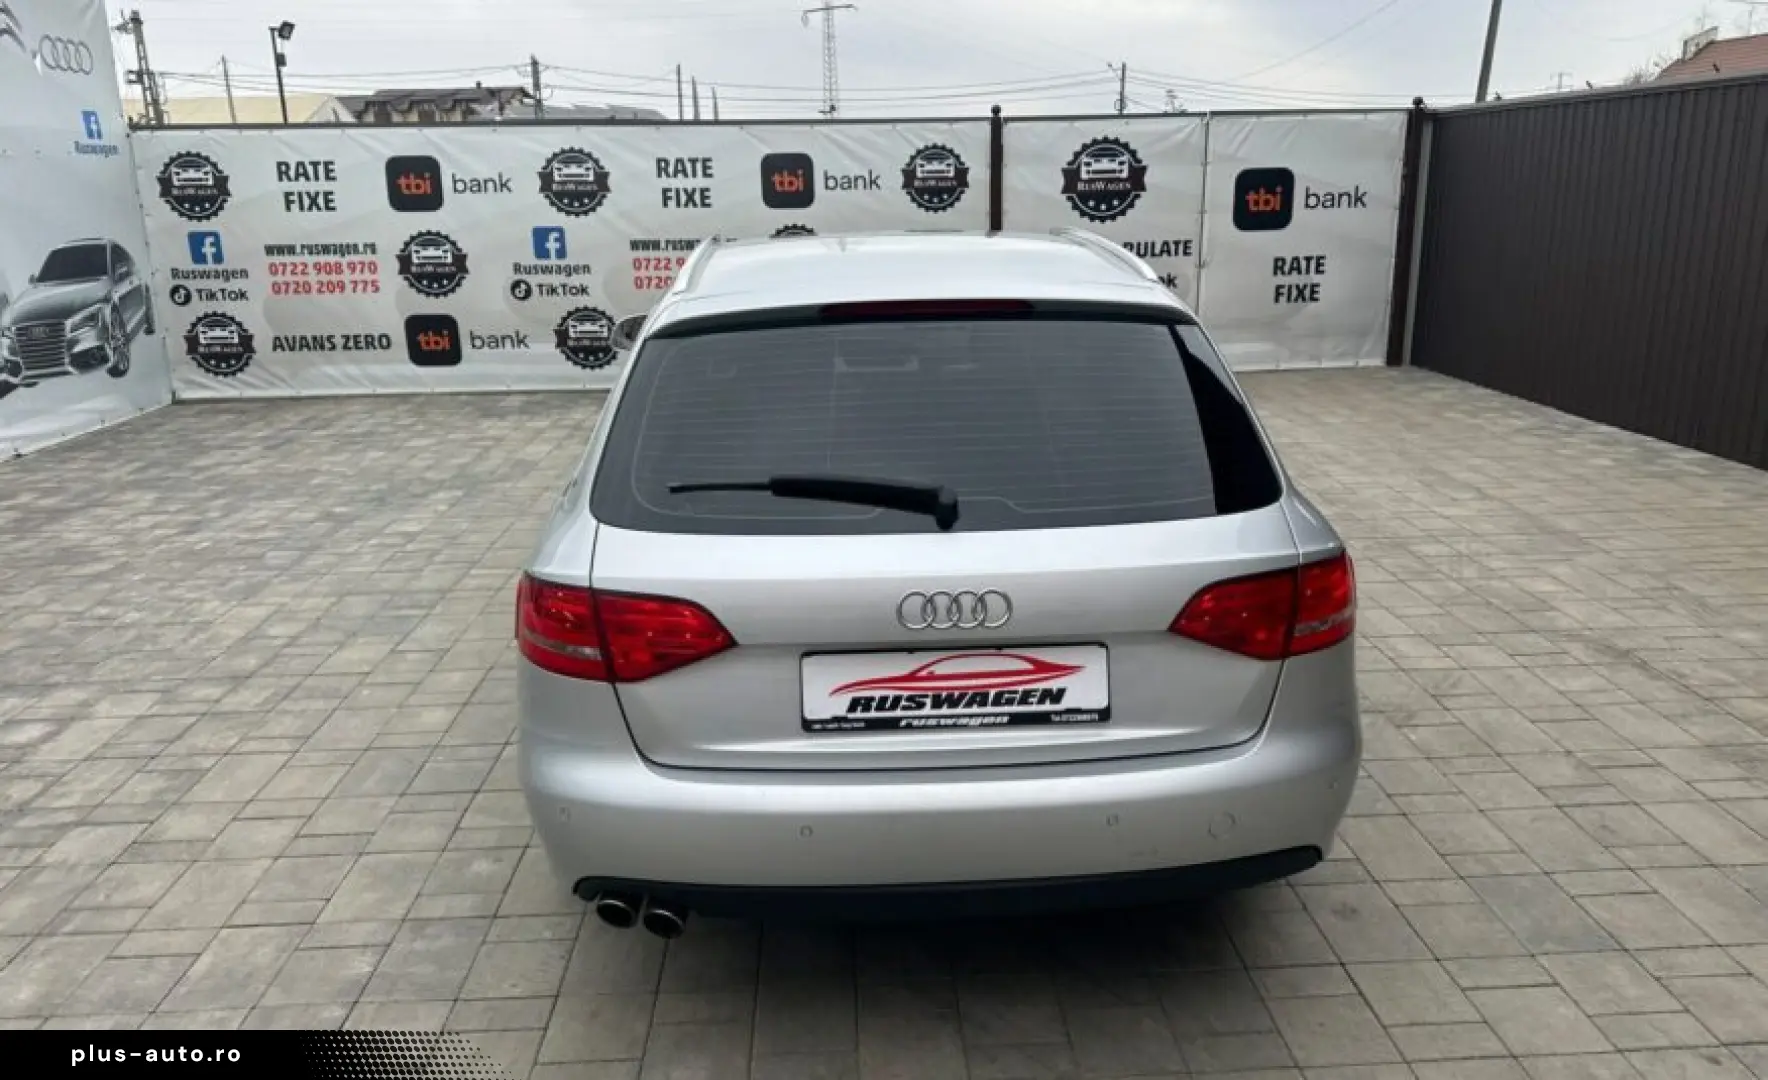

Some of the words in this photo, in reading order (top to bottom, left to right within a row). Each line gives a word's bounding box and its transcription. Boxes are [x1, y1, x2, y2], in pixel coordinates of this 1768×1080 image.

[275, 160, 338, 182] RATE
[655, 157, 714, 178] RATE
[397, 172, 433, 195] tbi
[452, 173, 513, 194] bank
[770, 169, 804, 192] tbi
[823, 169, 882, 191] bank
[283, 190, 338, 212] FIXE
[660, 187, 713, 209] FIXE
[1246, 185, 1284, 211] tbi
[1304, 184, 1368, 209] bank
[170, 267, 249, 281] Ruswagen
[268, 261, 309, 275] 0722
[313, 261, 344, 275] 908
[347, 260, 378, 275] 970
[512, 261, 592, 276] Ruswagen
[632, 257, 672, 271] 0722
[1272, 254, 1326, 276] RATE
[196, 287, 249, 302] TikTok
[272, 280, 312, 295] 0720
[316, 279, 345, 294] 209
[350, 278, 381, 293] 775
[535, 283, 590, 298] TikTok
[1273, 282, 1321, 304] FIXE
[271, 334, 336, 352] AVANS
[341, 332, 392, 351] ZERO
[416, 328, 451, 351] tbi
[469, 329, 530, 350] bank
[845, 687, 1068, 713] RUSWAGEN
